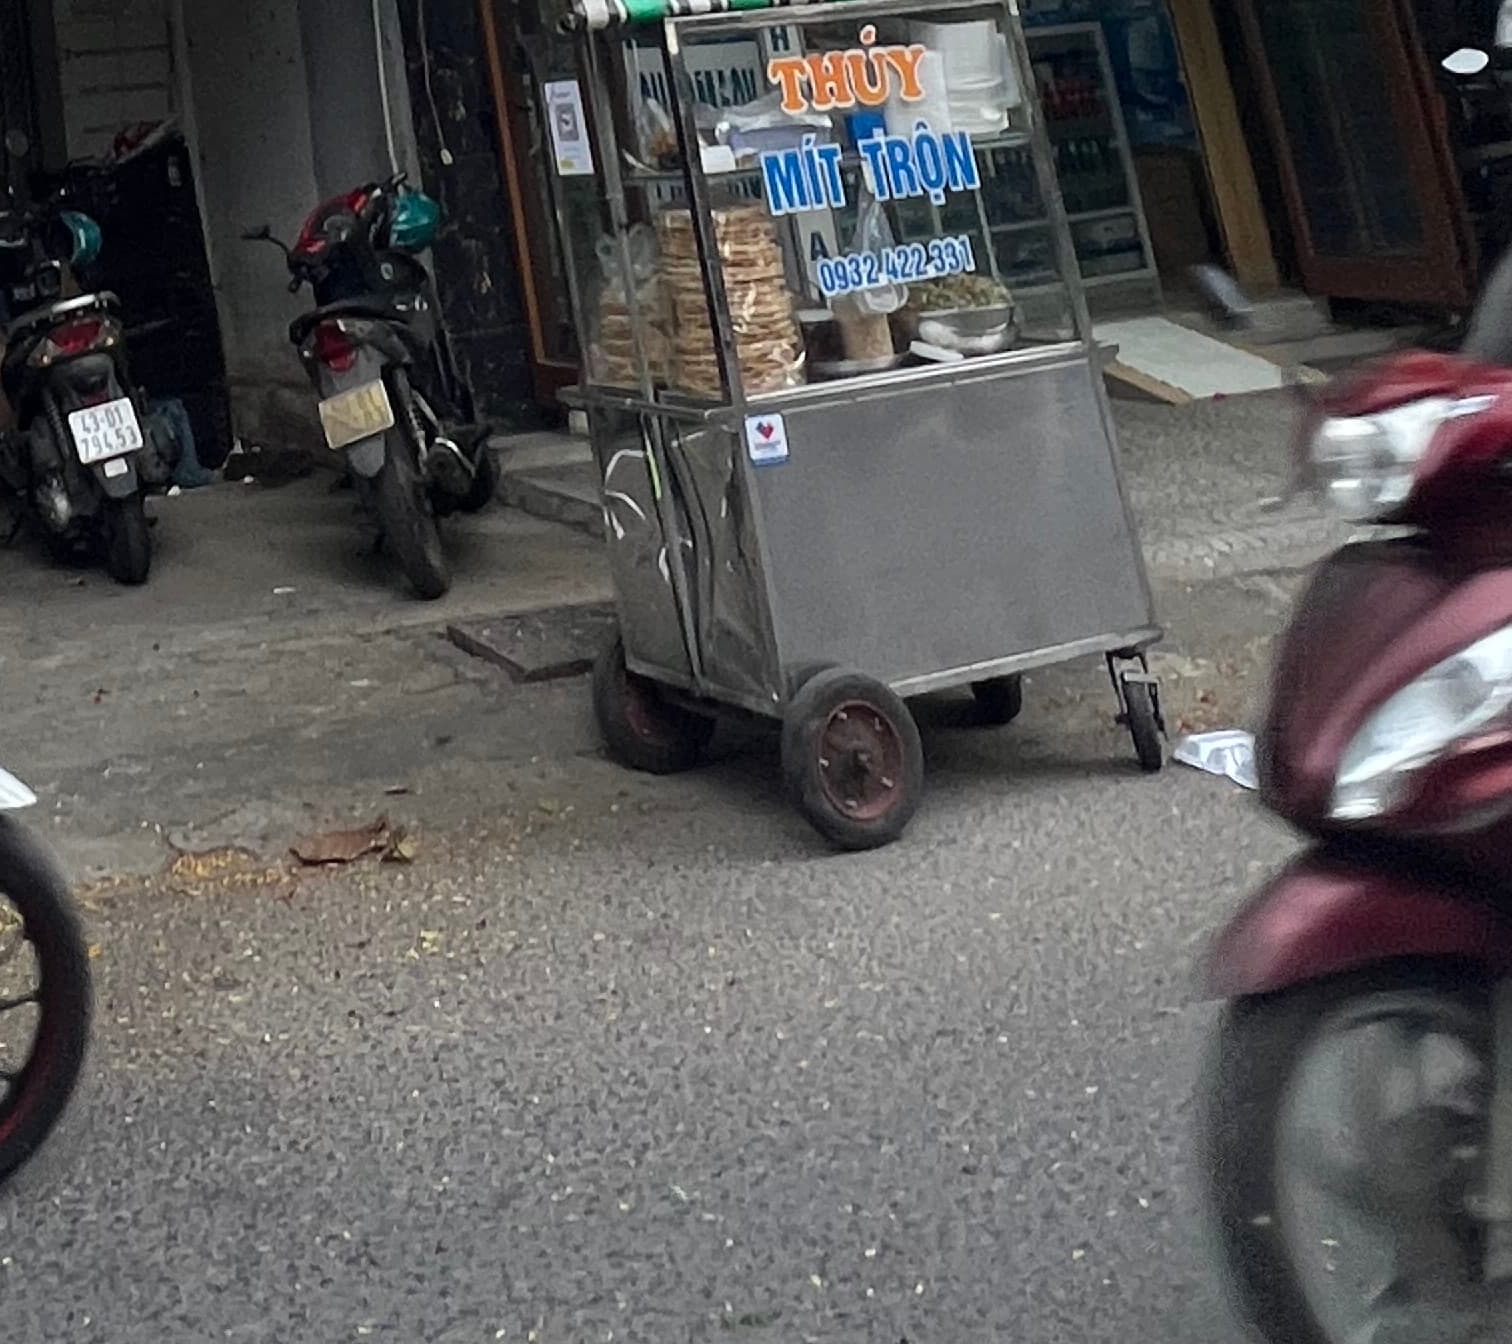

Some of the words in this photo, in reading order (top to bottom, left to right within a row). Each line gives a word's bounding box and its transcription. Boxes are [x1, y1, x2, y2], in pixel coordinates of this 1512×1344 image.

[767, 24, 928, 114] THỦY
[760, 133, 847, 216] MÍT
[858, 118, 981, 206] TRỘN
[818, 254, 880, 296] 0932
[882, 244, 928, 285] 422
[930, 234, 976, 276] 331
